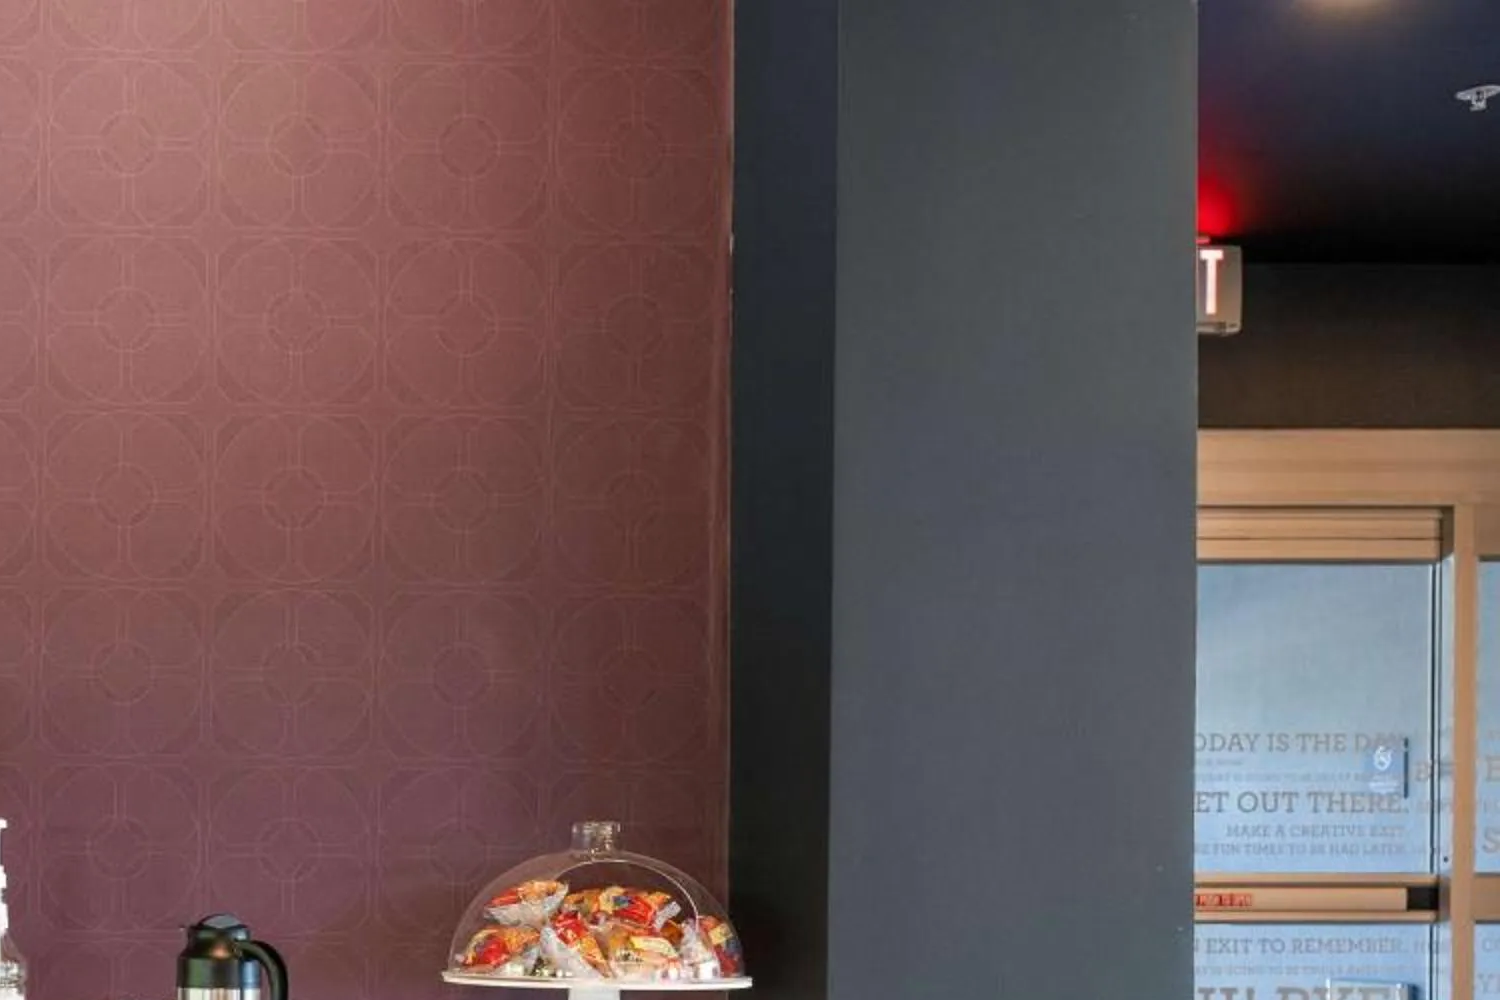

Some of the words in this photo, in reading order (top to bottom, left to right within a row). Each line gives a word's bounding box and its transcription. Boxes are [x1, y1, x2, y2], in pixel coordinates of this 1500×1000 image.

[1267, 733, 1290, 752] IS
[1295, 733, 1347, 752] THE
[1236, 791, 1299, 814] OUT
[1206, 938, 1252, 954] EXIT
[1257, 938, 1286, 954] TO
